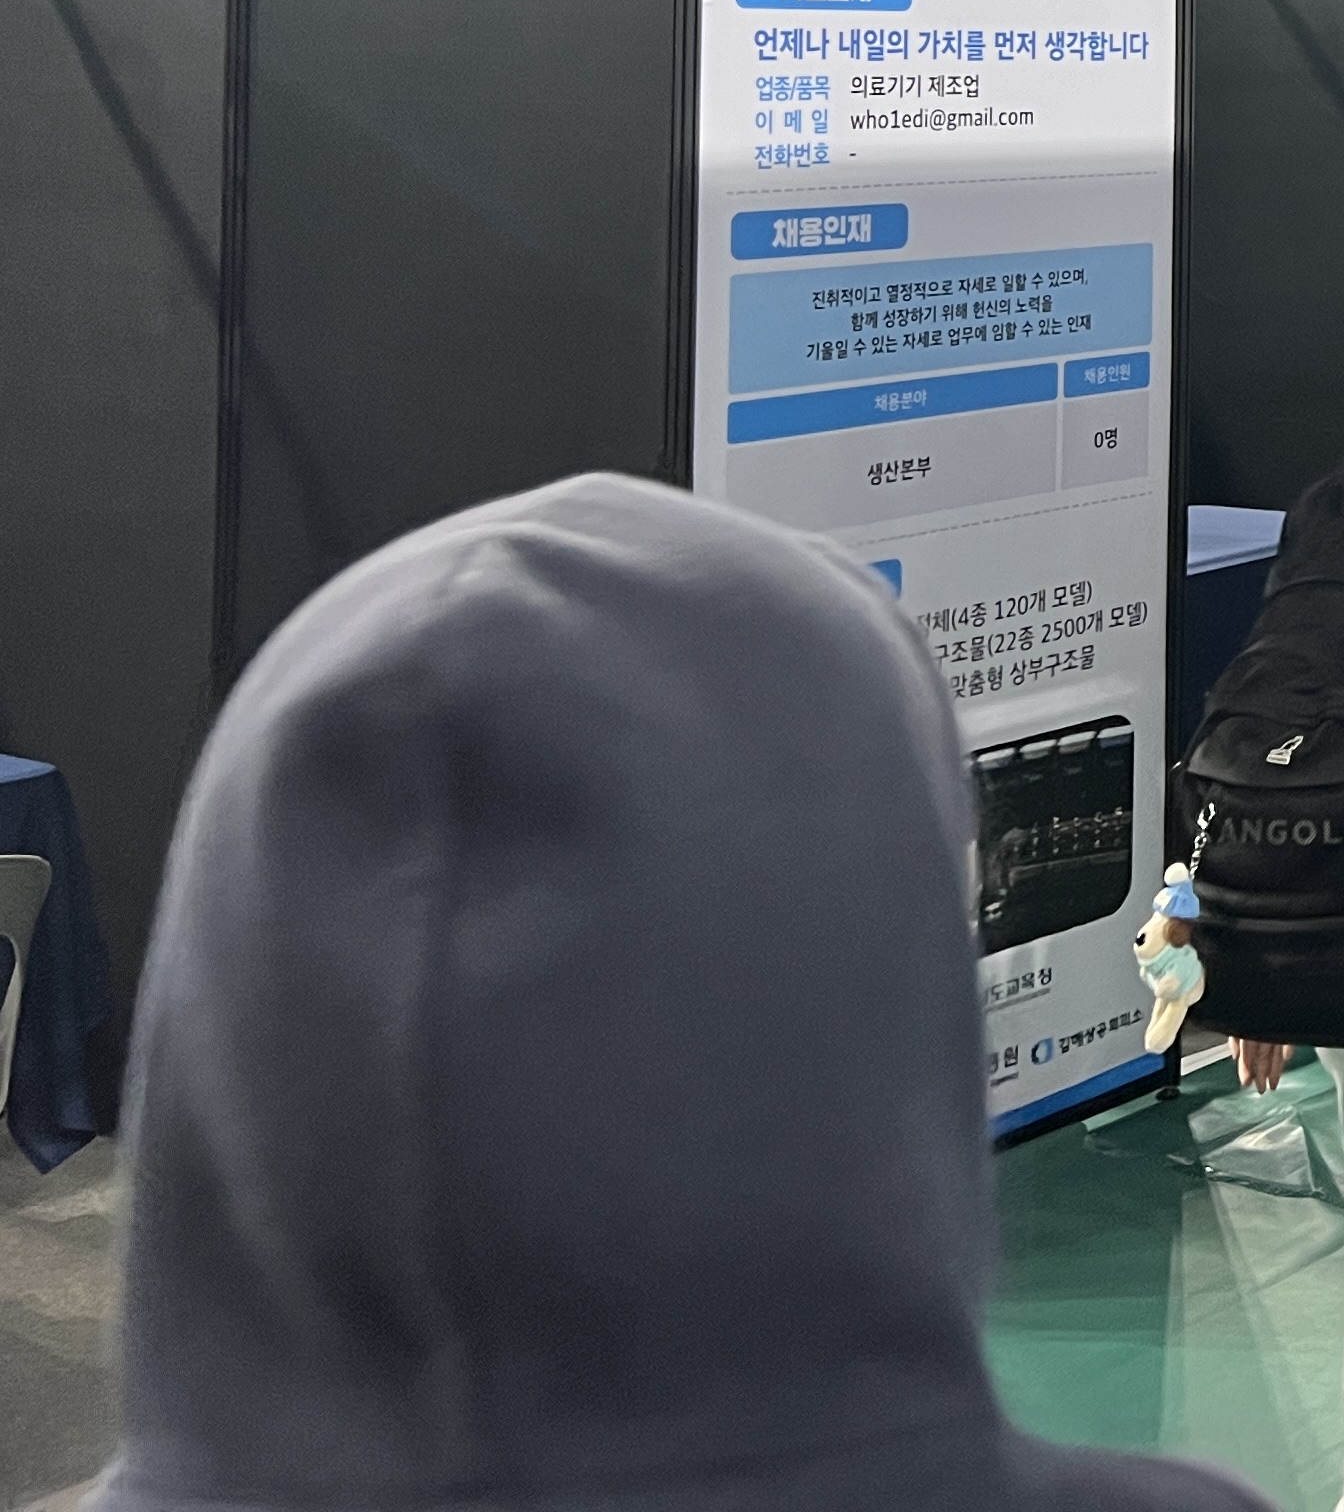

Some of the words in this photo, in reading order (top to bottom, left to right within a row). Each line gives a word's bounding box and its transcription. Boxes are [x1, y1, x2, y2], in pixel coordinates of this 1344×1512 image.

[753, 27, 831, 62] 언제나
[837, 28, 910, 62] 내일의
[917, 28, 988, 63] 가치를
[993, 29, 1038, 62] 먼저
[1044, 30, 1151, 62] 생각합니다
[754, 73, 832, 103] 업종/품목
[849, 73, 923, 100] 의료기기
[927, 73, 981, 100] 제조업
[849, 107, 1035, 133] who1edi@gmail.com
[753, 142, 832, 171] 전화번호
[771, 213, 873, 250] 채용인재
[811, 286, 882, 311] 진취적이고
[886, 280, 954, 304] 열정적으로
[958, 275, 997, 295] 자세로
[1001, 273, 1028, 292] 일할
[1030, 272, 1044, 290] 수
[850, 310, 878, 332] 함께
[882, 305, 937, 329] 성장하기
[941, 302, 968, 322] 위해
[972, 298, 1011, 319] 헌신의
[1015, 294, 1054, 314] 노력을
[805, 338, 849, 362] 기울일
[852, 338, 867, 356] 수
[871, 335, 898, 356] 있는
[902, 329, 944, 351] 자세로
[947, 324, 988, 347] 업무에
[1021, 320, 1035, 337] 수
[1038, 317, 1064, 337] 있는
[1066, 313, 1093, 333] 인재
[1083, 362, 1133, 385] 채용인원
[873, 388, 928, 413] 채용분야
[866, 455, 933, 488] 생산본부
[993, 589, 1047, 622] 120개
[1051, 580, 1093, 609] 모델)
[1040, 607, 1104, 645] 2500개
[1107, 600, 1149, 630] 모델)
[950, 665, 1004, 700] 맞춤형
[1009, 643, 1096, 685] 상부구조물
[1201, 817, 1343, 846] ANGOL
